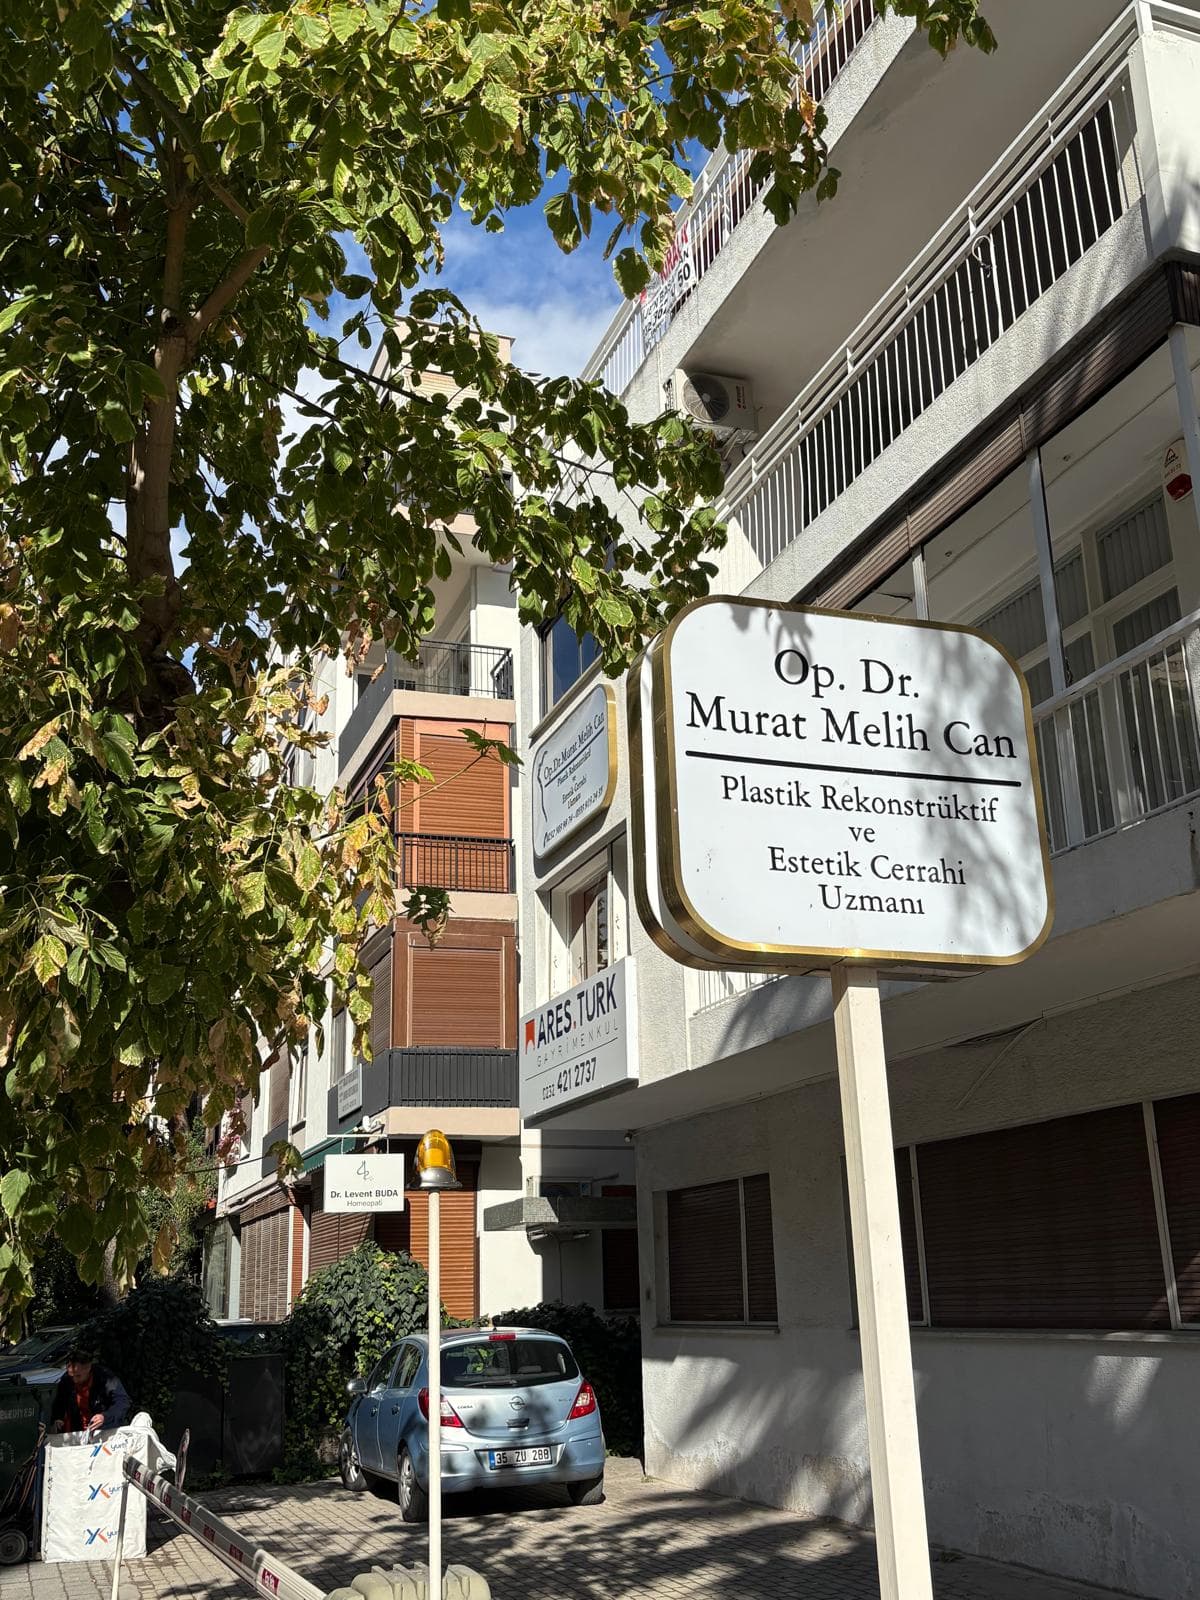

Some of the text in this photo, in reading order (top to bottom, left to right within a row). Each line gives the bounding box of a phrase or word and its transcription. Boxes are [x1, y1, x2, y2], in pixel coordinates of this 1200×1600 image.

[774, 649, 920, 698] Op. Dr.
[685, 691, 1018, 759] Murat Melih Can
[721, 775, 999, 822] Plastik Rekonstrüktif
[848, 825, 876, 843] ve
[768, 846, 966, 885] Estetik Cerrahi
[818, 884, 925, 915] Uzmanı
[542, 1057, 597, 1100] 0232 421 2737
[344, 1190, 373, 1199] Levent
[375, 1189, 399, 1198] BUDA
[496, 1449, 549, 1465] 35 ZU 288
